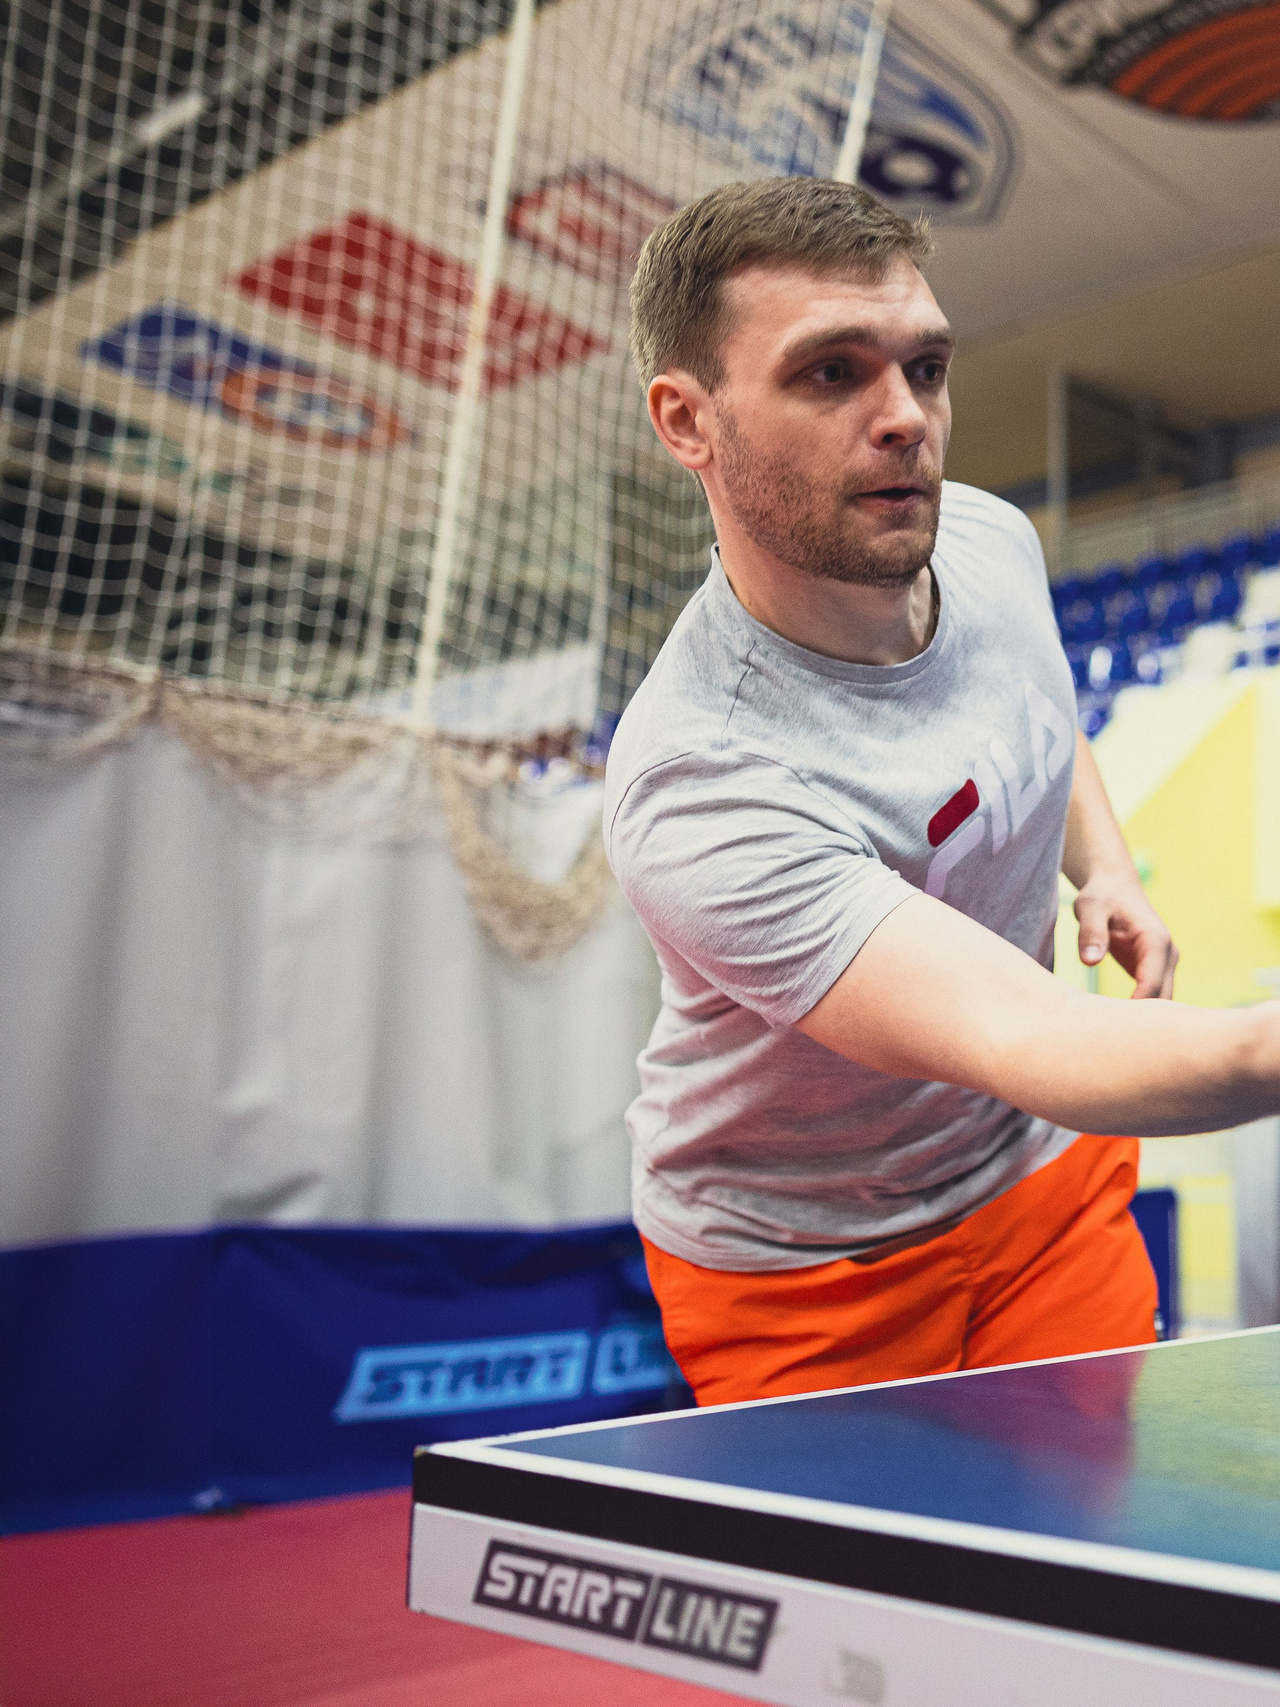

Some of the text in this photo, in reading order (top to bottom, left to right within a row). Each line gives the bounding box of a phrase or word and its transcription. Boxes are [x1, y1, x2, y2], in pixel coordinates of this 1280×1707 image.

[360, 1350, 575, 1402] START
[483, 1551, 766, 1660] START LINE
